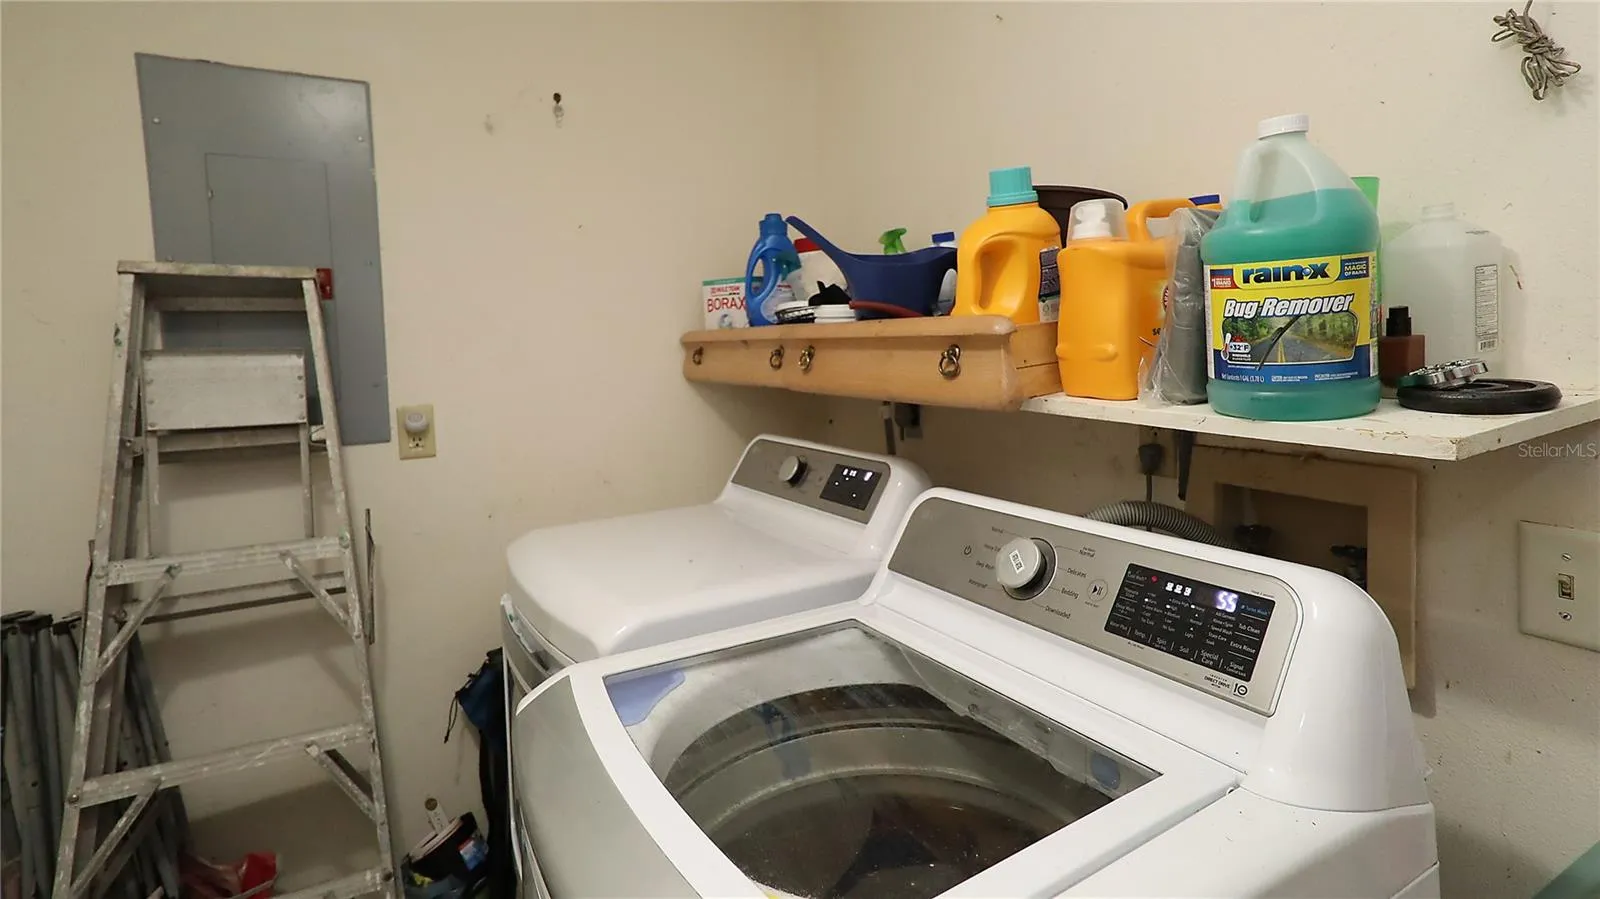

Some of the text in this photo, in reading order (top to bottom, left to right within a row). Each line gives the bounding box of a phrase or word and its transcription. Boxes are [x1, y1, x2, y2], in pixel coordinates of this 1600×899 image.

[707, 296, 747, 313] BORAX
[1224, 293, 1355, 318] Bug Remover
[1061, 587, 1079, 599] Bedding
[1215, 590, 1239, 613] 55
[1045, 605, 1071, 620] Downloaded
[1246, 625, 1261, 635] Clean
[1229, 640, 1256, 654] Extra Rinse
[1200, 649, 1219, 661] Special
[1201, 656, 1214, 666] Care
